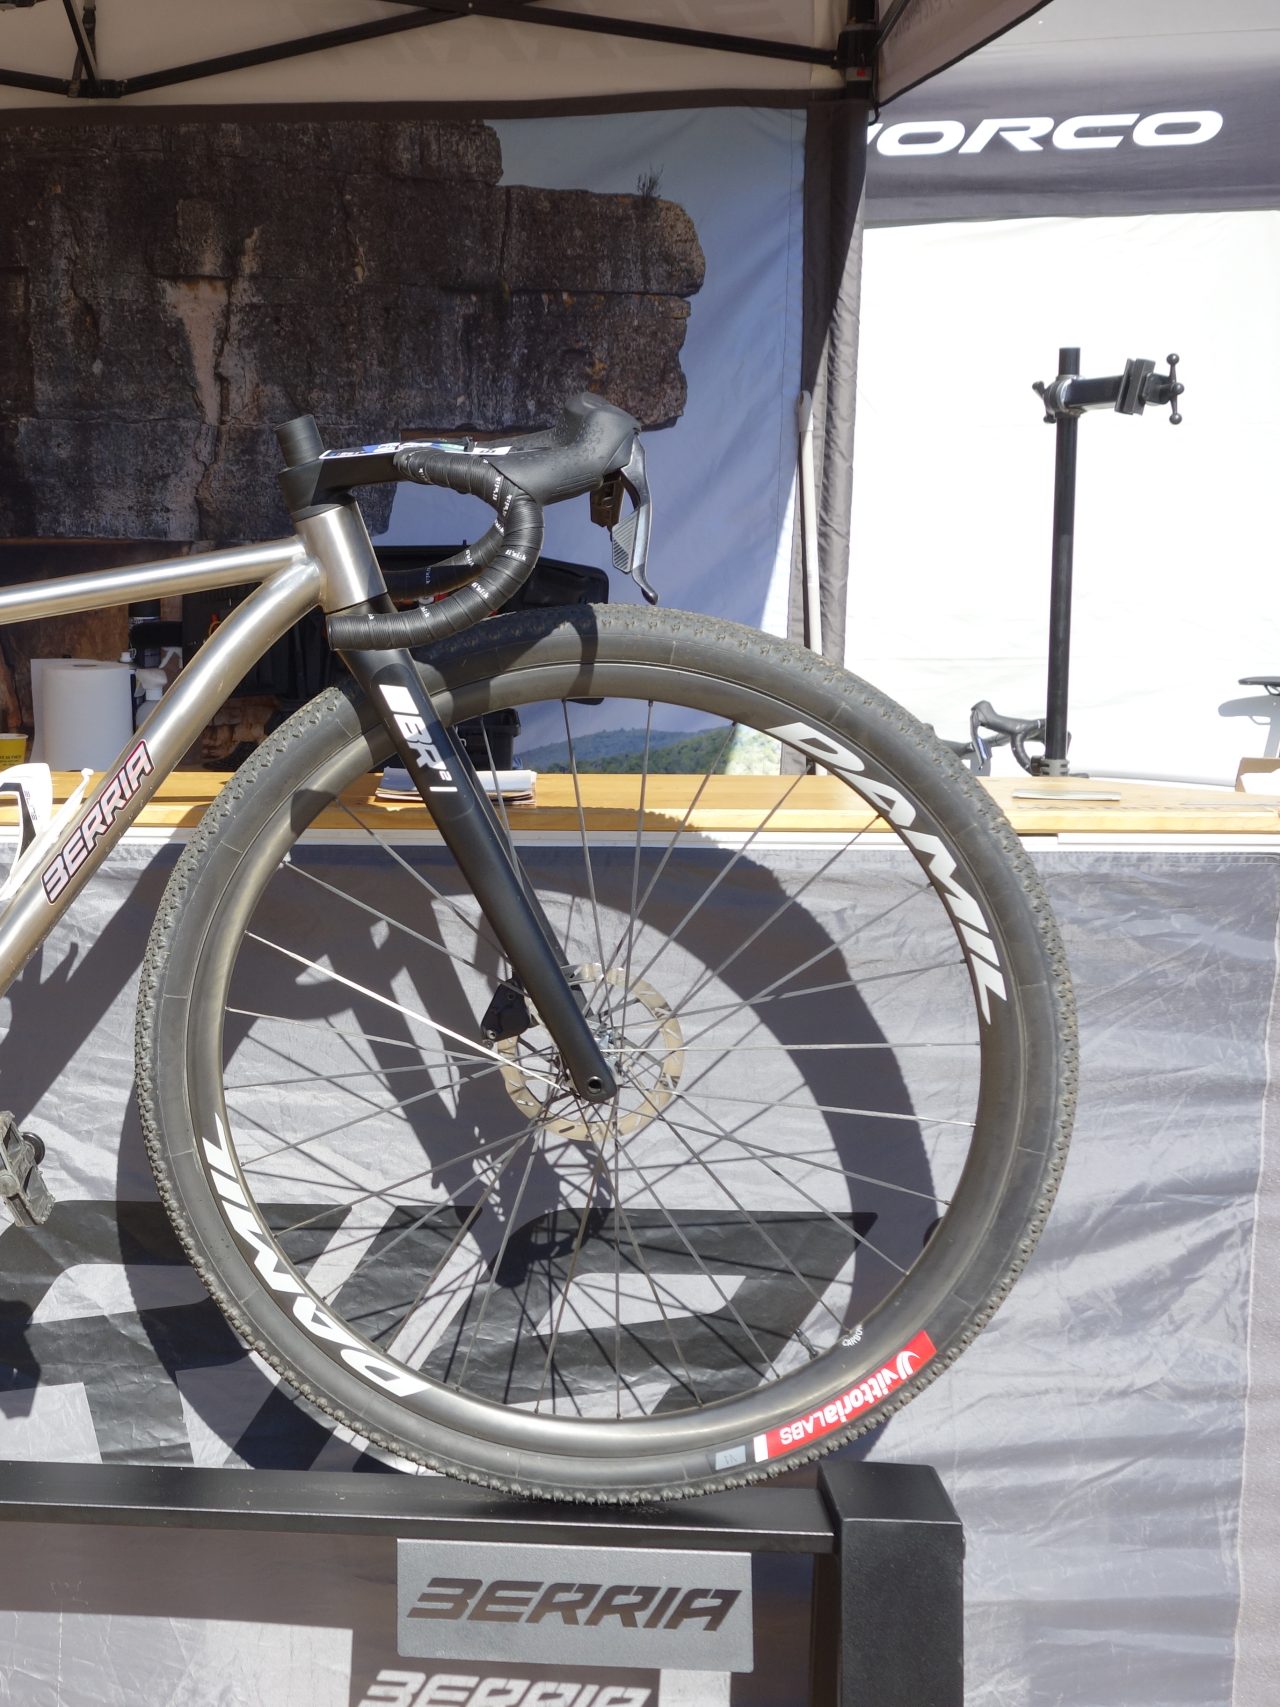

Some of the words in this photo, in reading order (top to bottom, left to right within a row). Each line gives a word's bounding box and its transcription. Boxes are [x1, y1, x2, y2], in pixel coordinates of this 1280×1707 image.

[868, 110, 1223, 157] ORCO
[42, 740, 155, 904] BERRIA
[764, 722, 1007, 1025] DAMIL
[407, 1577, 742, 1632] BERRIA
